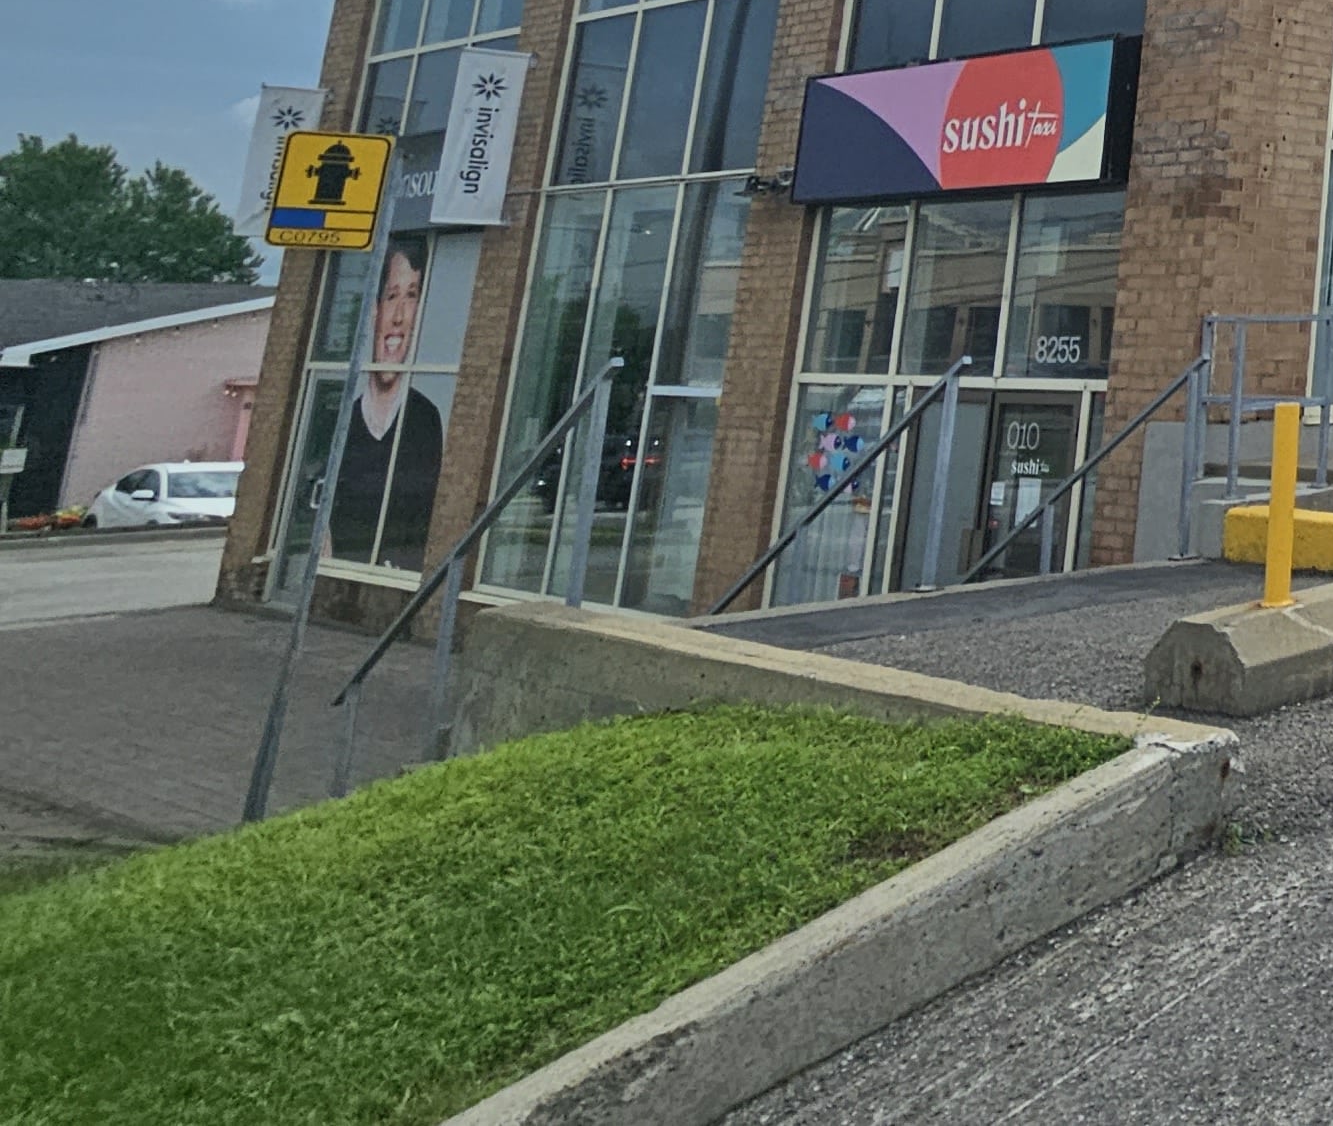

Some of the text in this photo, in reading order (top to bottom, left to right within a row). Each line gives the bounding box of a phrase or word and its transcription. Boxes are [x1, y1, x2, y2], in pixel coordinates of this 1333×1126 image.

[943, 98, 1027, 153] sushi
[1027, 100, 1059, 148] taxi
[460, 107, 500, 194] invisalign
[279, 230, 341, 244] C0795
[1035, 336, 1081, 364] 8255
[1007, 421, 1040, 450] 010
[1010, 459, 1040, 475] sushi
